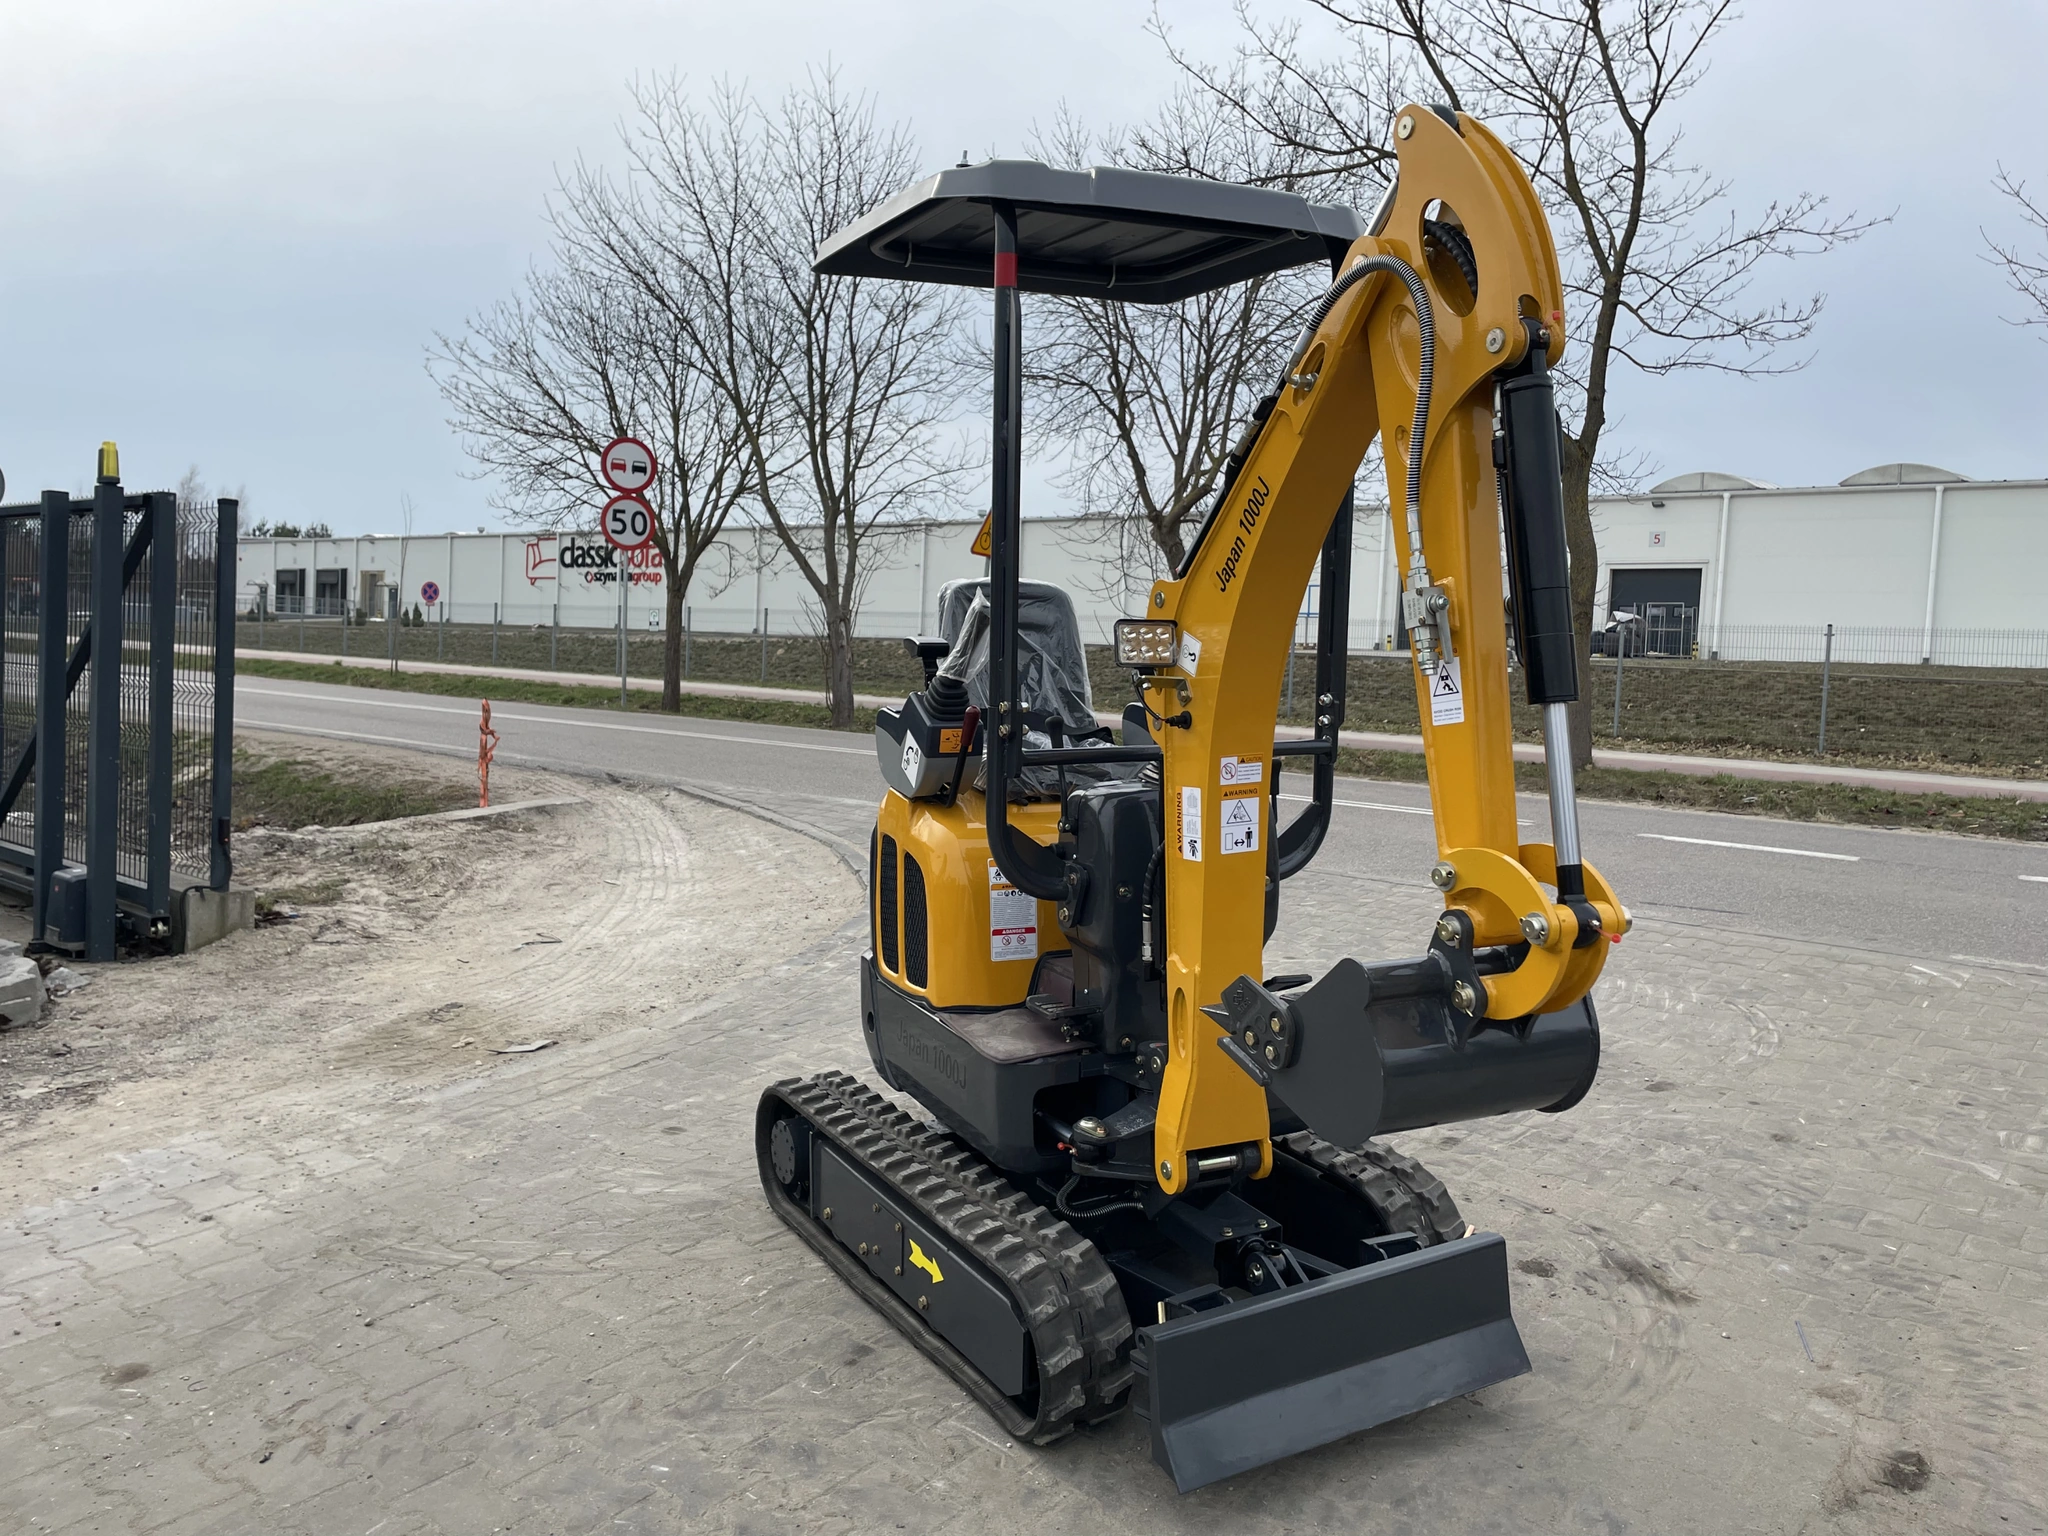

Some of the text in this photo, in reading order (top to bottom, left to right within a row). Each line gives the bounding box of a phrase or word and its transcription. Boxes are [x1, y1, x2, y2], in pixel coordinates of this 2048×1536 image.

[610, 509, 648, 537] 50
[1215, 475, 1270, 592] Japan 1000J
[1653, 533, 1661, 545] 5
[1228, 787, 1258, 796] WARNING
[897, 1020, 967, 1090] Japan 1000J
